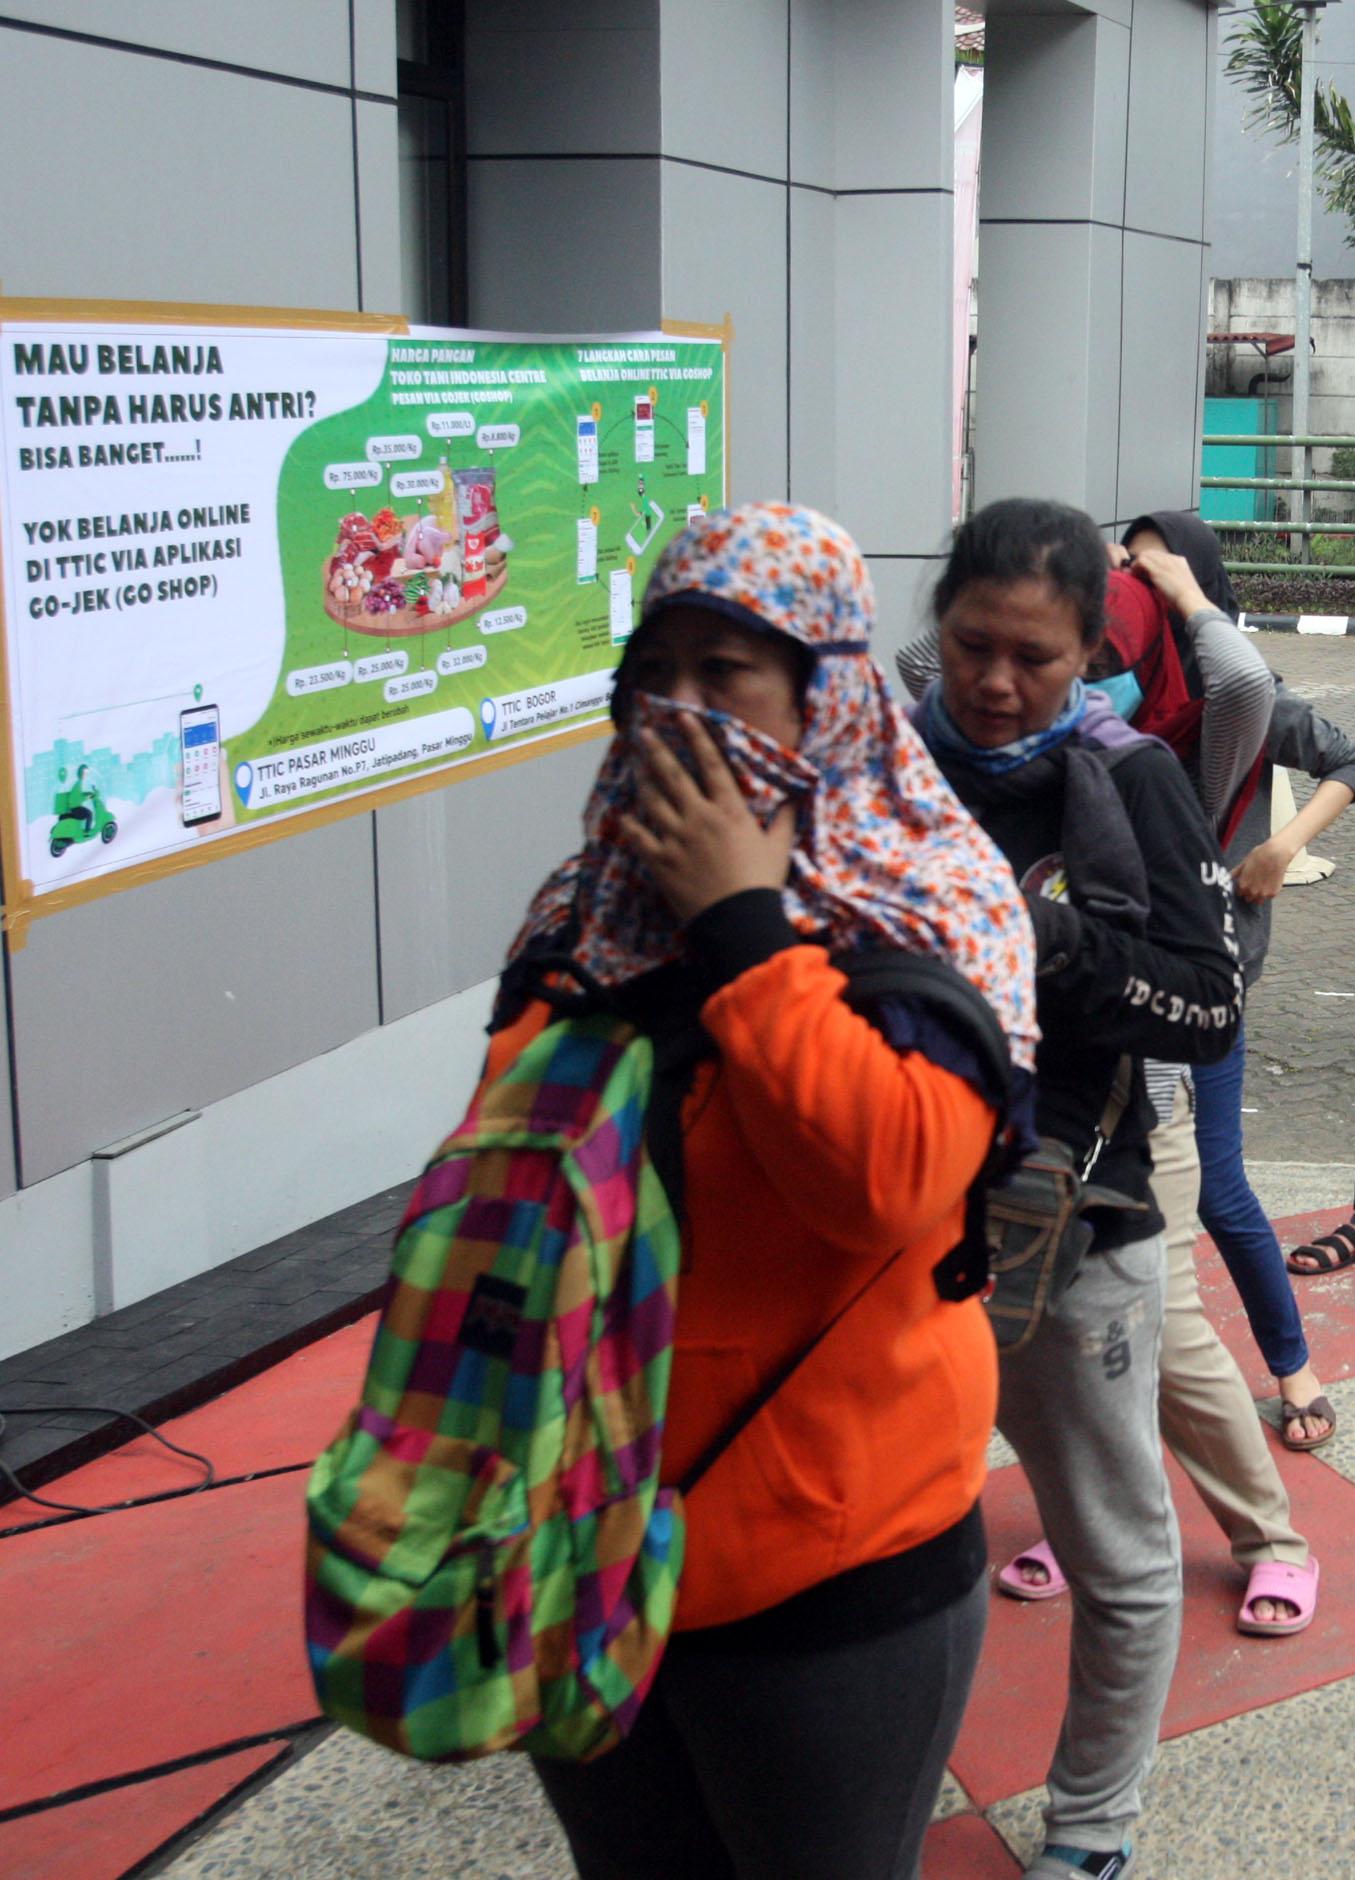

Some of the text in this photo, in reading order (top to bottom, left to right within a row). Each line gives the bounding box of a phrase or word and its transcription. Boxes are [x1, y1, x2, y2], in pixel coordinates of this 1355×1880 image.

[14, 343, 224, 375] MAU BELANJA
[391, 348, 475, 363] HARGA PANGAN
[627, 350, 650, 362] CARA
[390, 369, 547, 385] TOKO TANI INDONESIA CENTRE
[669, 368, 682, 379] VIA
[15, 391, 317, 427] TANPA HARUS ANTRI?
[392, 391, 424, 405] PESAN
[424, 391, 440, 404] VIA
[19, 444, 74, 471] BISA
[23, 503, 250, 545] YOK BELANJA ONLINE
[26, 538, 242, 583] DI TTIC VIA APLIKASI
[29, 574, 217, 619] GO-JEK (GO SHOP)
[502, 690, 557, 715] TTIC BOGOR
[257, 737, 376, 781] TTIC PASAR MINGGU
[259, 788, 272, 799] Jl.
[274, 780, 297, 796] Raya
[300, 770, 339, 789] Ragunan
[422, 741, 443, 755] Pasar
[445, 733, 473, 748] Minggu
